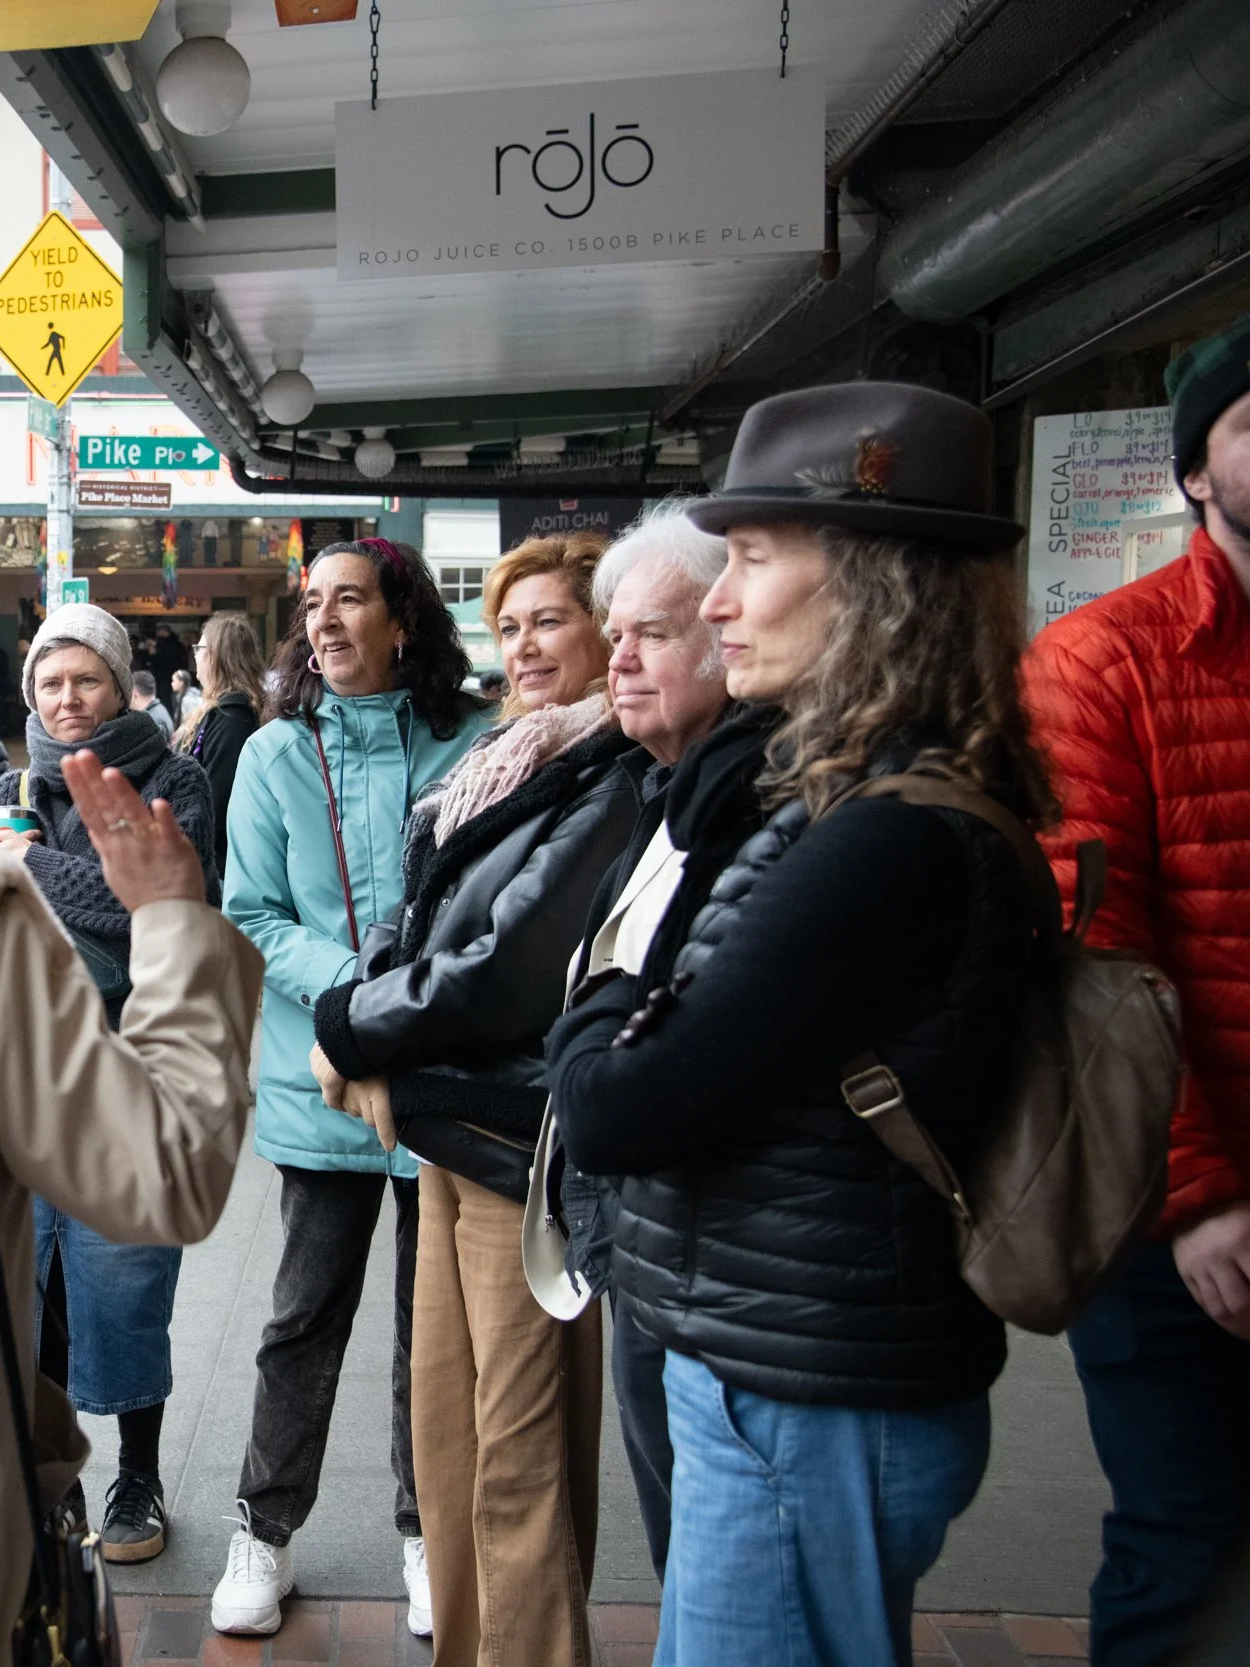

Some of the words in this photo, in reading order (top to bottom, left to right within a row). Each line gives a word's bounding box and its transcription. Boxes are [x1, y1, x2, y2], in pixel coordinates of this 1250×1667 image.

[359, 248, 421, 265] ROJO
[433, 244, 501, 262] JUICE
[568, 234, 638, 252] 1500B
[652, 229, 706, 246] PIKE
[721, 224, 800, 241] PLACE
[30, 247, 78, 267] YIELD
[45, 272, 64, 288] TO
[87, 438, 141, 465] Pike
[1072, 441, 1099, 457] FLO
[81, 491, 103, 502] Pike
[104, 491, 131, 503] Place
[132, 493, 168, 504] Market
[1048, 444, 1071, 553] SPECIAL
[531, 515, 568, 531] ADITI
[572, 511, 609, 528] CHAI
[1072, 531, 1119, 546] GINGER
[1070, 547, 1101, 559] APPLE
